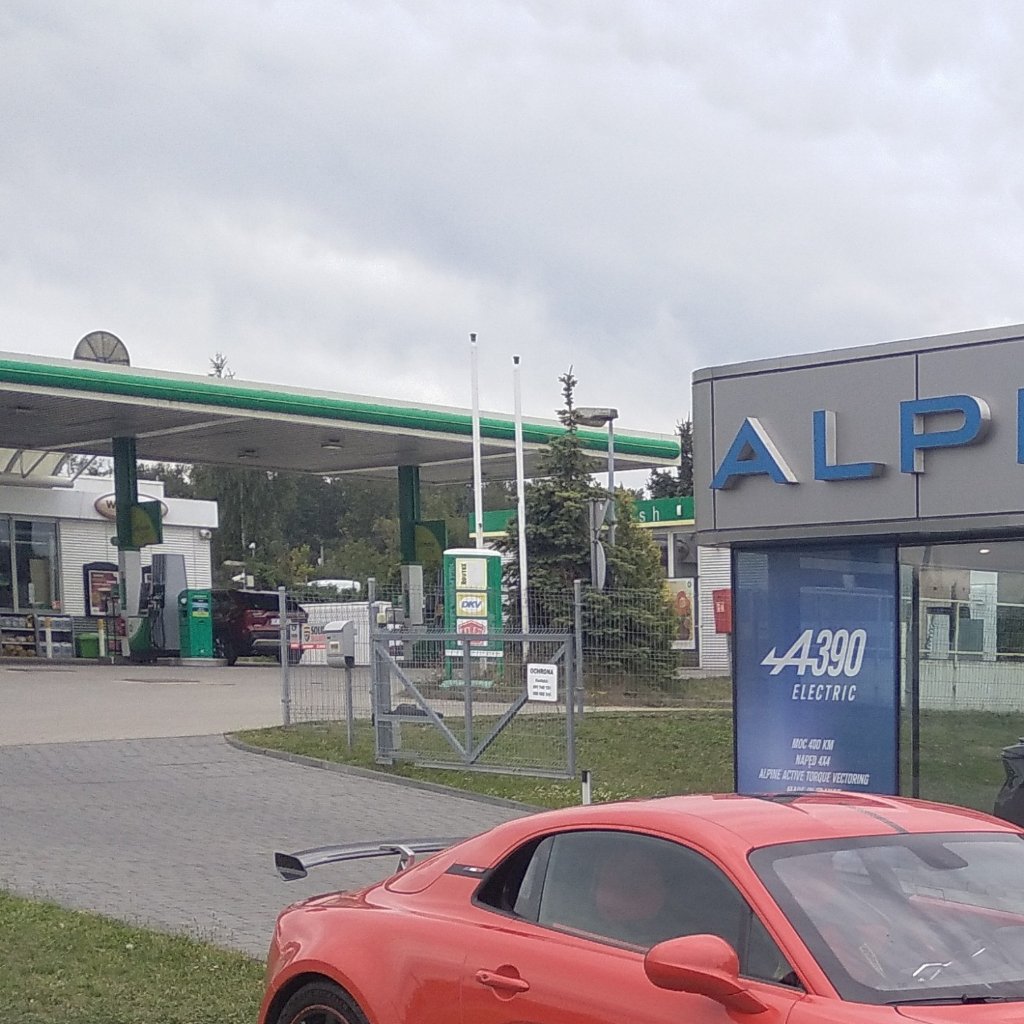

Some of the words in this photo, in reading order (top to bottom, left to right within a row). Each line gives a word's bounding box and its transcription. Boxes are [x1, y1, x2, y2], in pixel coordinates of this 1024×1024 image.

[461, 600, 481, 609] DKV
[792, 683, 857, 702] ELECTRIC
[792, 738, 808, 750] MOC
[808, 738, 821, 750] 400
[822, 739, 835, 751] KM
[759, 768, 781, 780] ALPINE
[782, 770, 805, 782] ACTIVE
[806, 771, 831, 784] TORQUE
[832, 772, 870, 786] VECTORING
